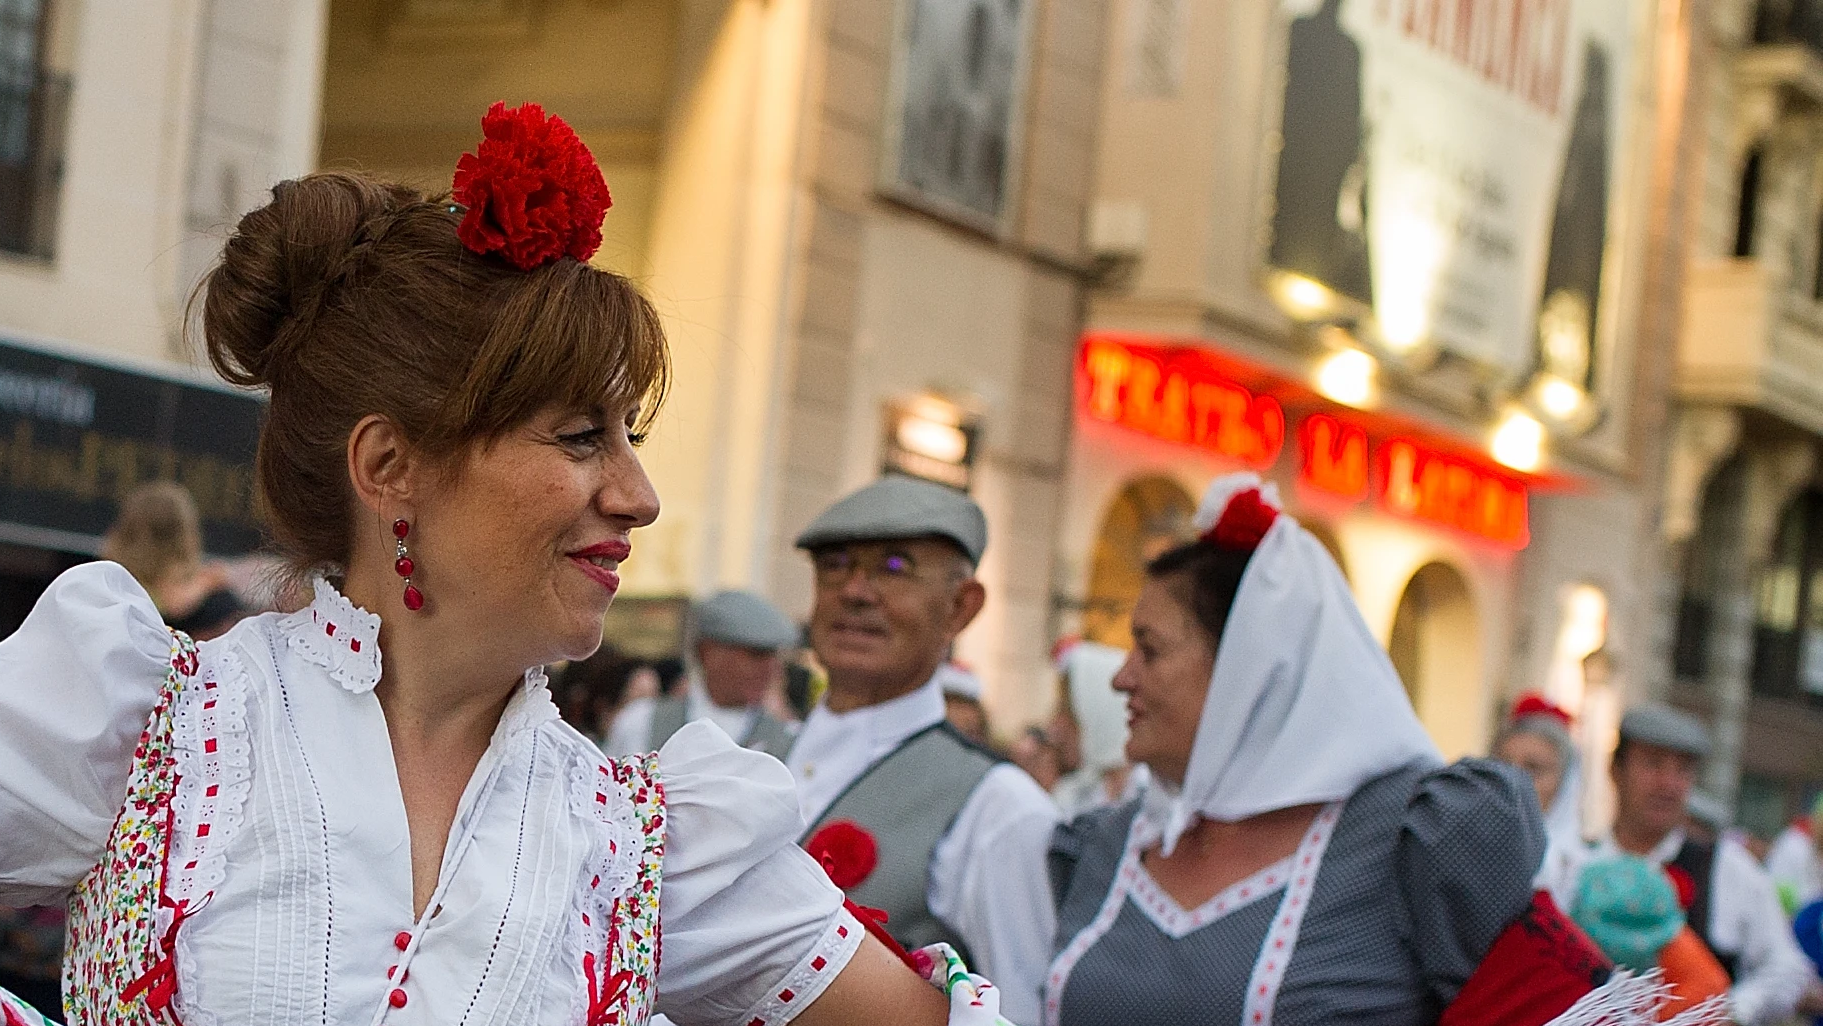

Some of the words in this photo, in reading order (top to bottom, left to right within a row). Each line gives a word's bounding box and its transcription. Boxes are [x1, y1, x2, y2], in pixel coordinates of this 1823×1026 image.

[1086, 341, 1284, 469] TEATRO
[1307, 414, 1370, 498] LA
[1388, 439, 1529, 547] LATINA
